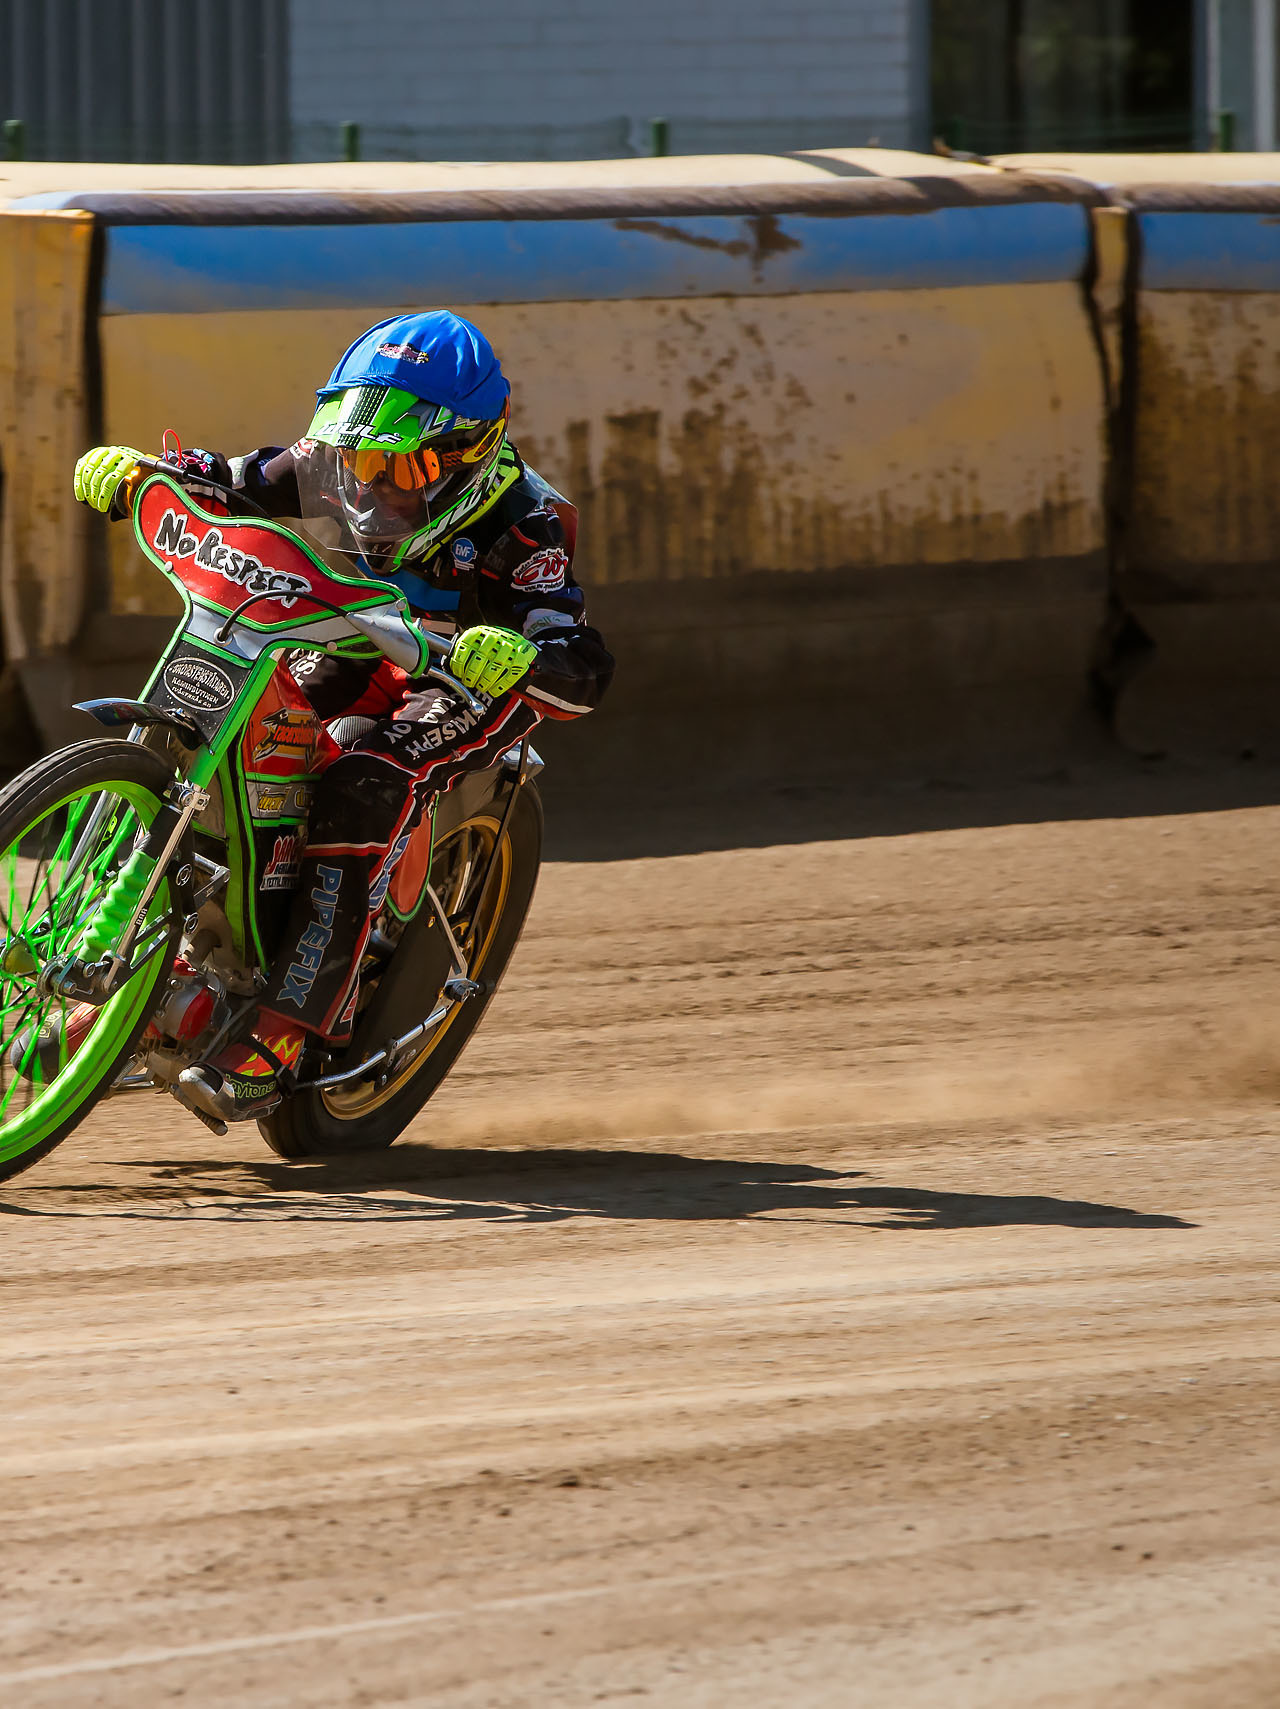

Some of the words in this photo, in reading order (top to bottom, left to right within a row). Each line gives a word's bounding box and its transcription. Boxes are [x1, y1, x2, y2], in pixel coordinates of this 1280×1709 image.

[316, 421, 402, 446] WULF
[383, 723, 413, 745] OY
[276, 863, 343, 1008] PIPEFIX
[226, 1072, 276, 1099] aytona
